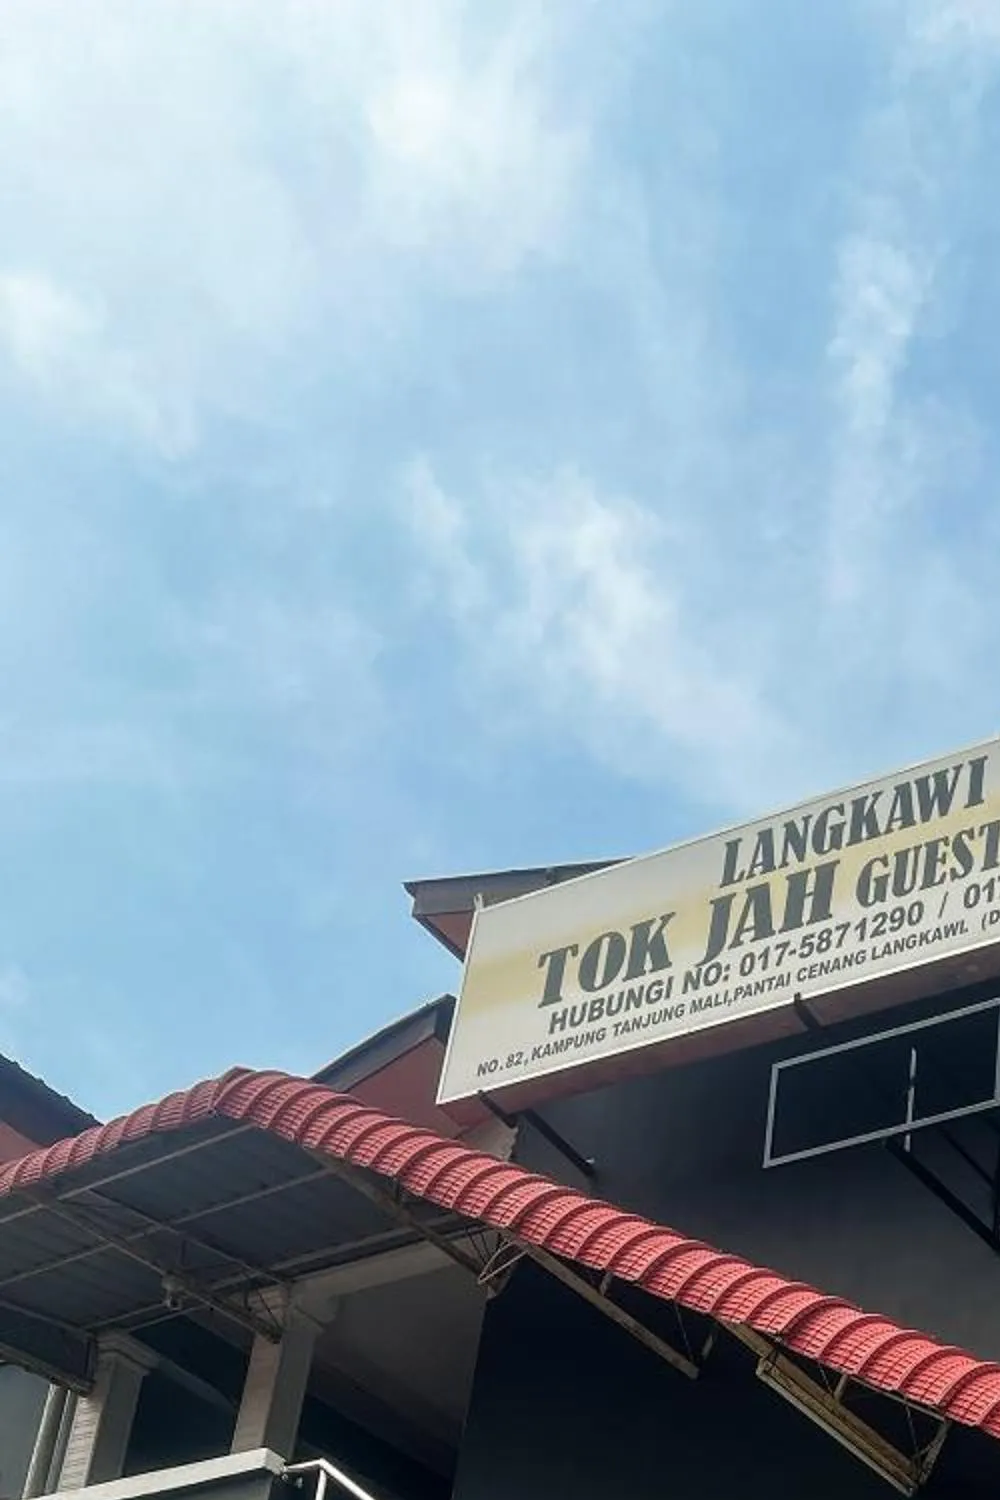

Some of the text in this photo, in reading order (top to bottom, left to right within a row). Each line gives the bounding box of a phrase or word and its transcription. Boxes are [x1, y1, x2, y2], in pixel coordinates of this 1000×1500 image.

[719, 754, 989, 889] LANGKAWI
[537, 911, 677, 1009] TOK
[695, 860, 841, 968] JAH
[548, 976, 674, 1035] HUBUNGI
[681, 961, 732, 994] NO:
[739, 899, 925, 978] 017-5871290
[936, 890, 950, 919] /
[530, 1027, 607, 1063] KAMPUNG
[613, 1004, 686, 1037] TANJUNG
[796, 950, 867, 984] CENANG
